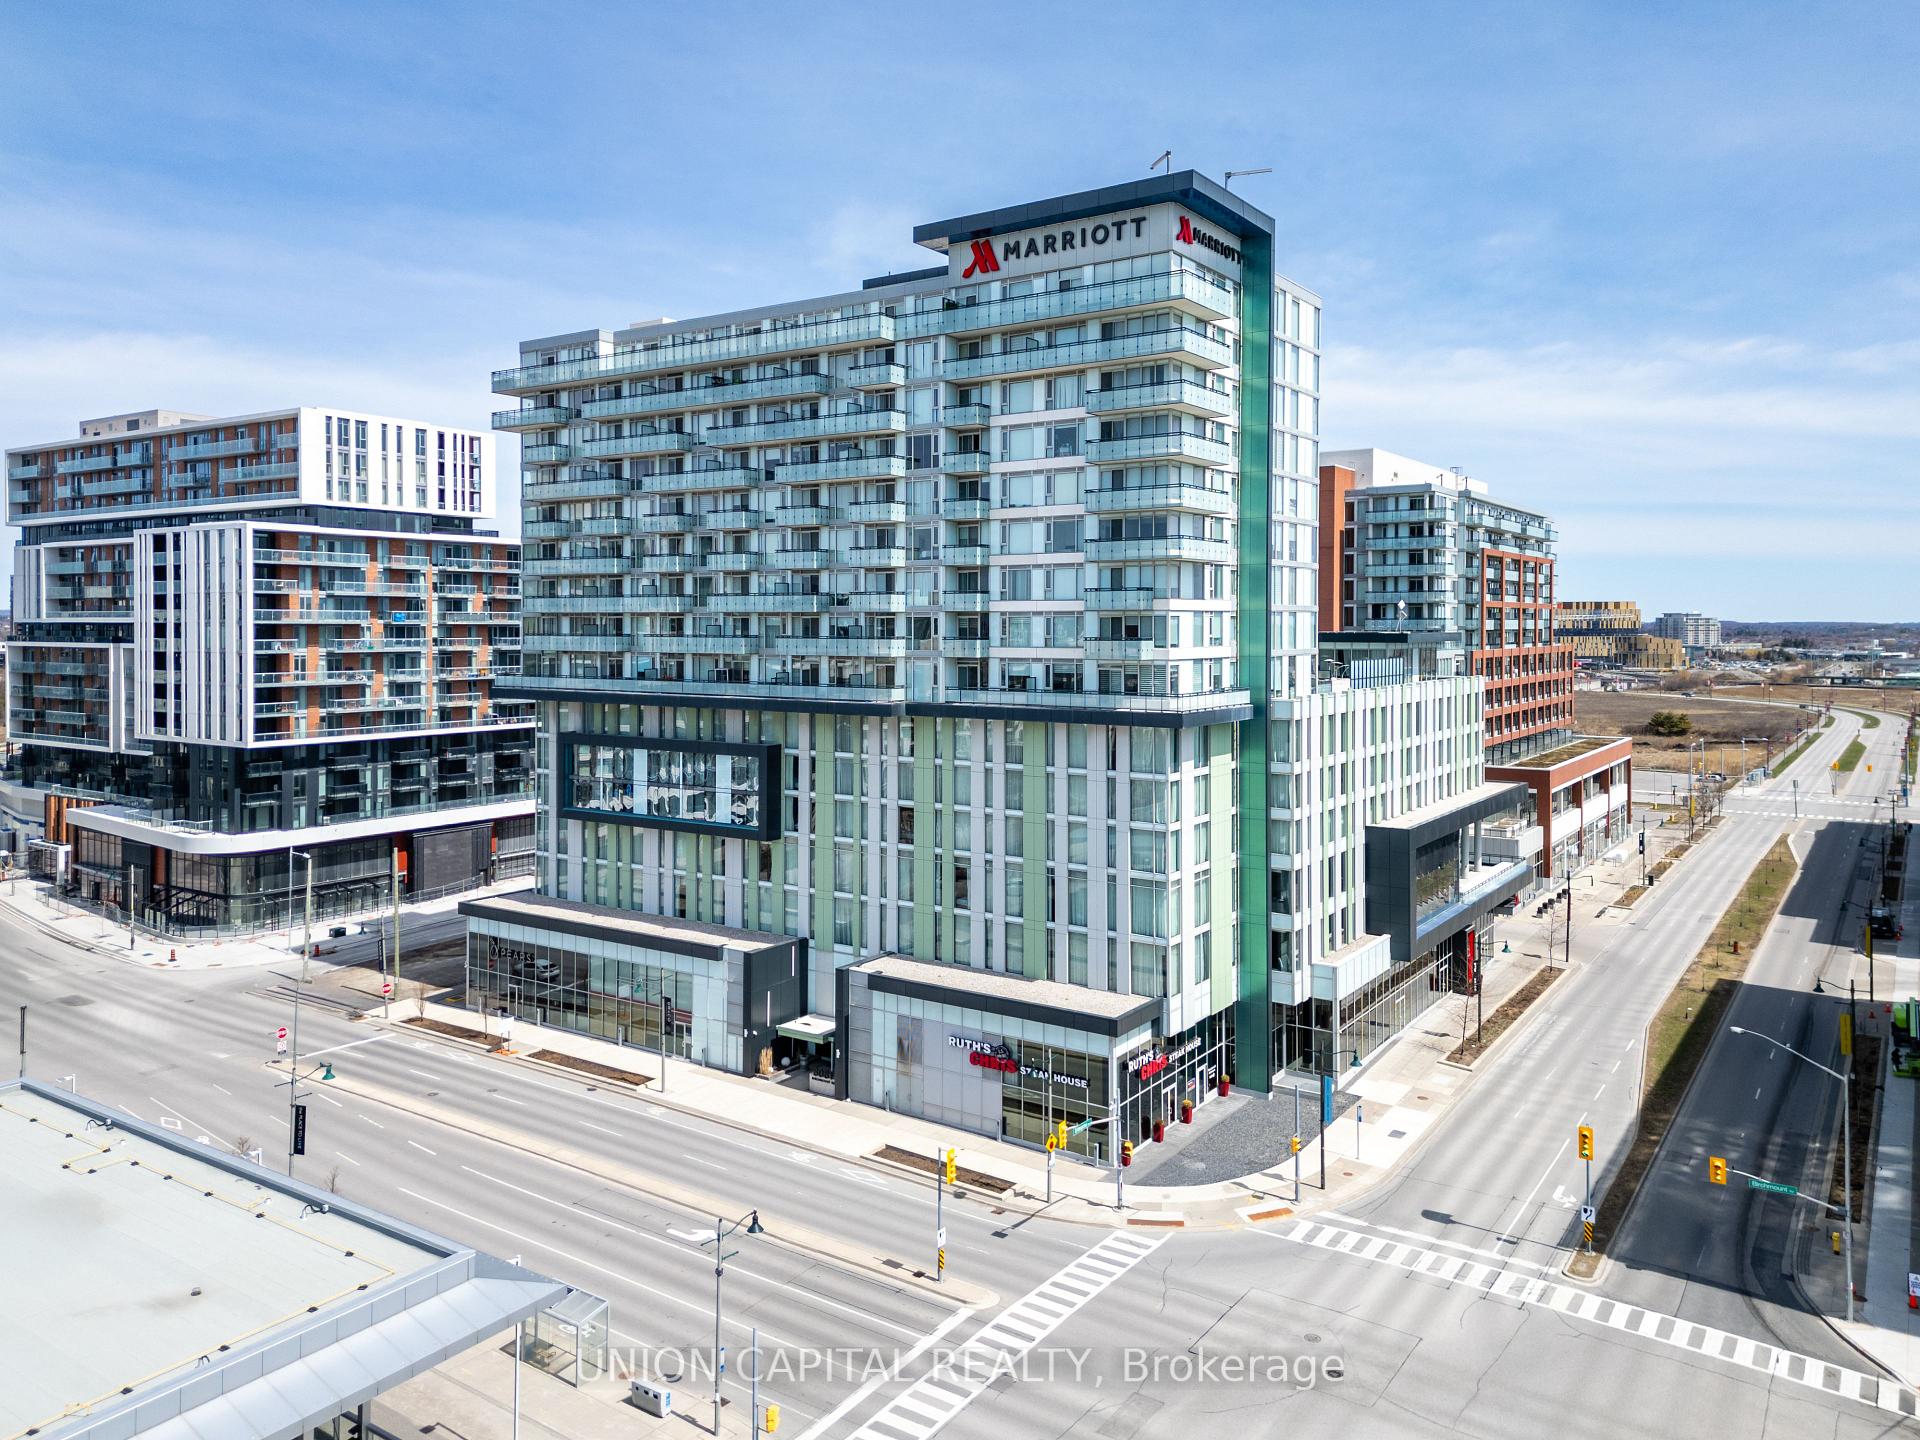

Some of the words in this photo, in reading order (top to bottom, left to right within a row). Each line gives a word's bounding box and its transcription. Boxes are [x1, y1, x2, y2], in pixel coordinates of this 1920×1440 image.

[1003, 216, 1147, 262] MARRIOTT
[1193, 227, 1241, 264] MARRIOTT
[949, 1036, 991, 1054] RUTH'S
[1129, 1050, 1154, 1073] RUTH'S
[1053, 1073, 1088, 1088] HOUSE
